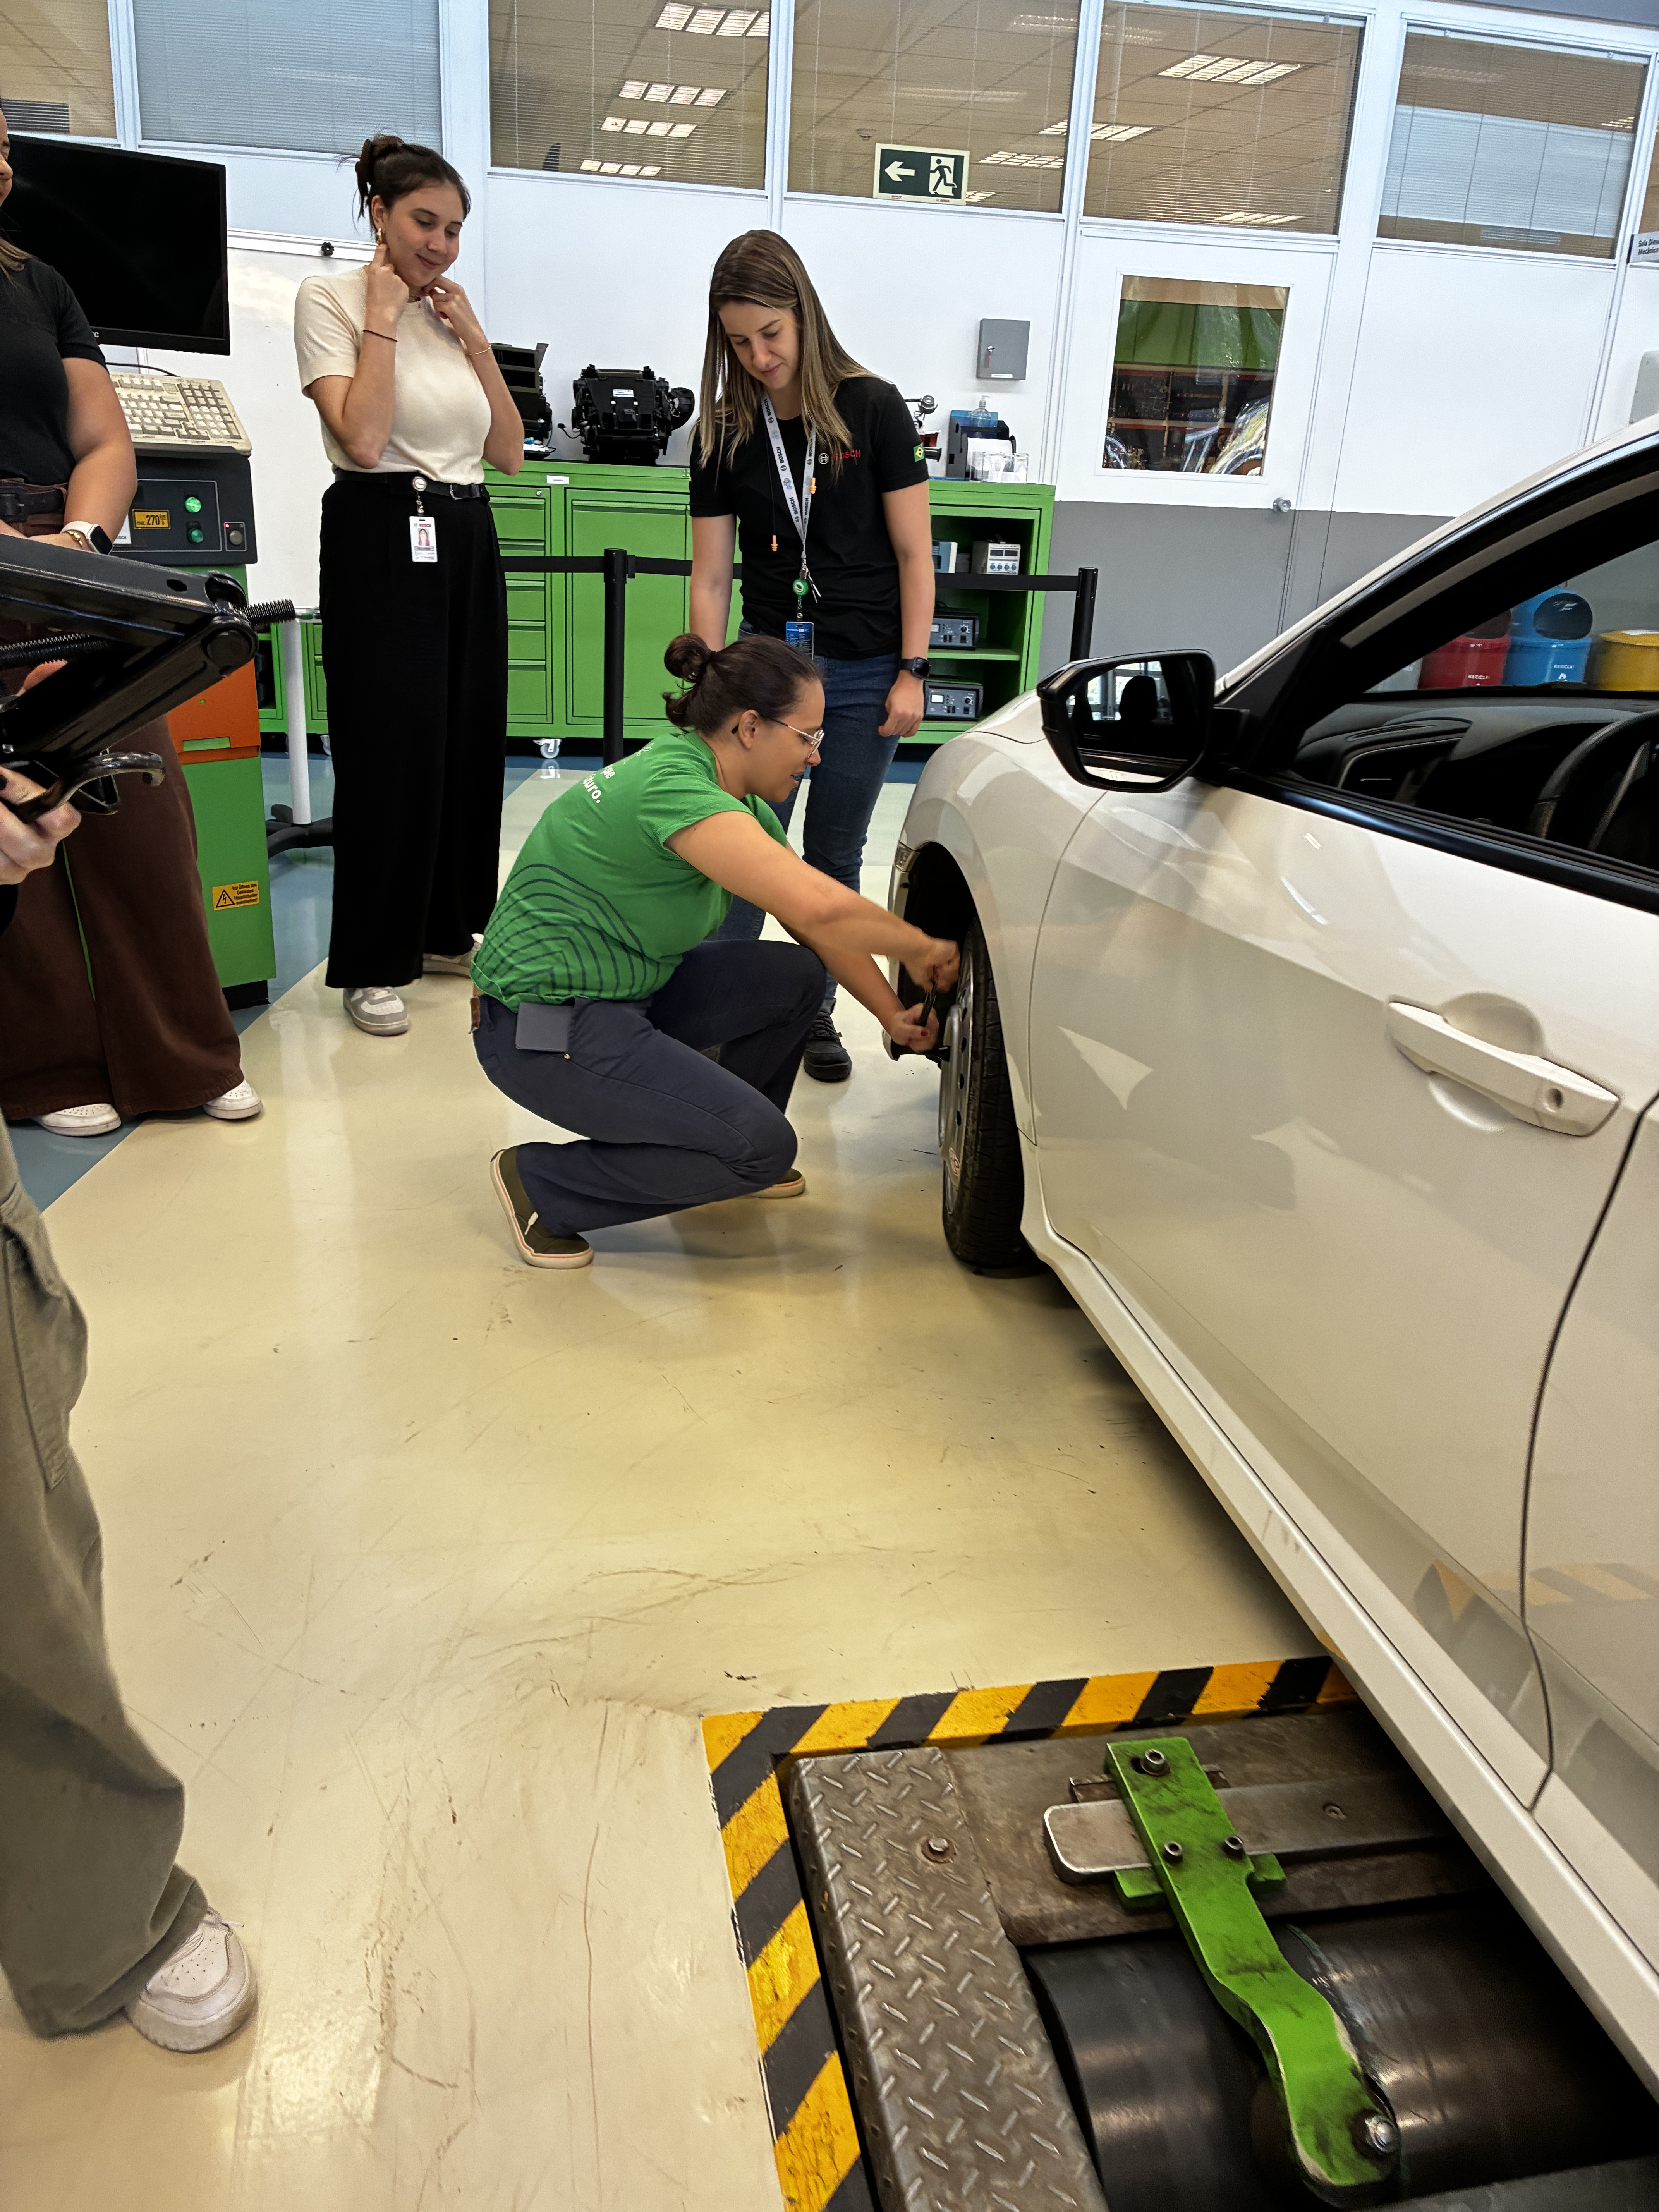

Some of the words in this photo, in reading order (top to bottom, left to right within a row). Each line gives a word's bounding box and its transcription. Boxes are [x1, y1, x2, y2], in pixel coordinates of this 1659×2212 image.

[776, 446, 785, 464] BOSCH
[789, 497, 799, 515] BOSCH
[146, 515, 160, 525] 270
